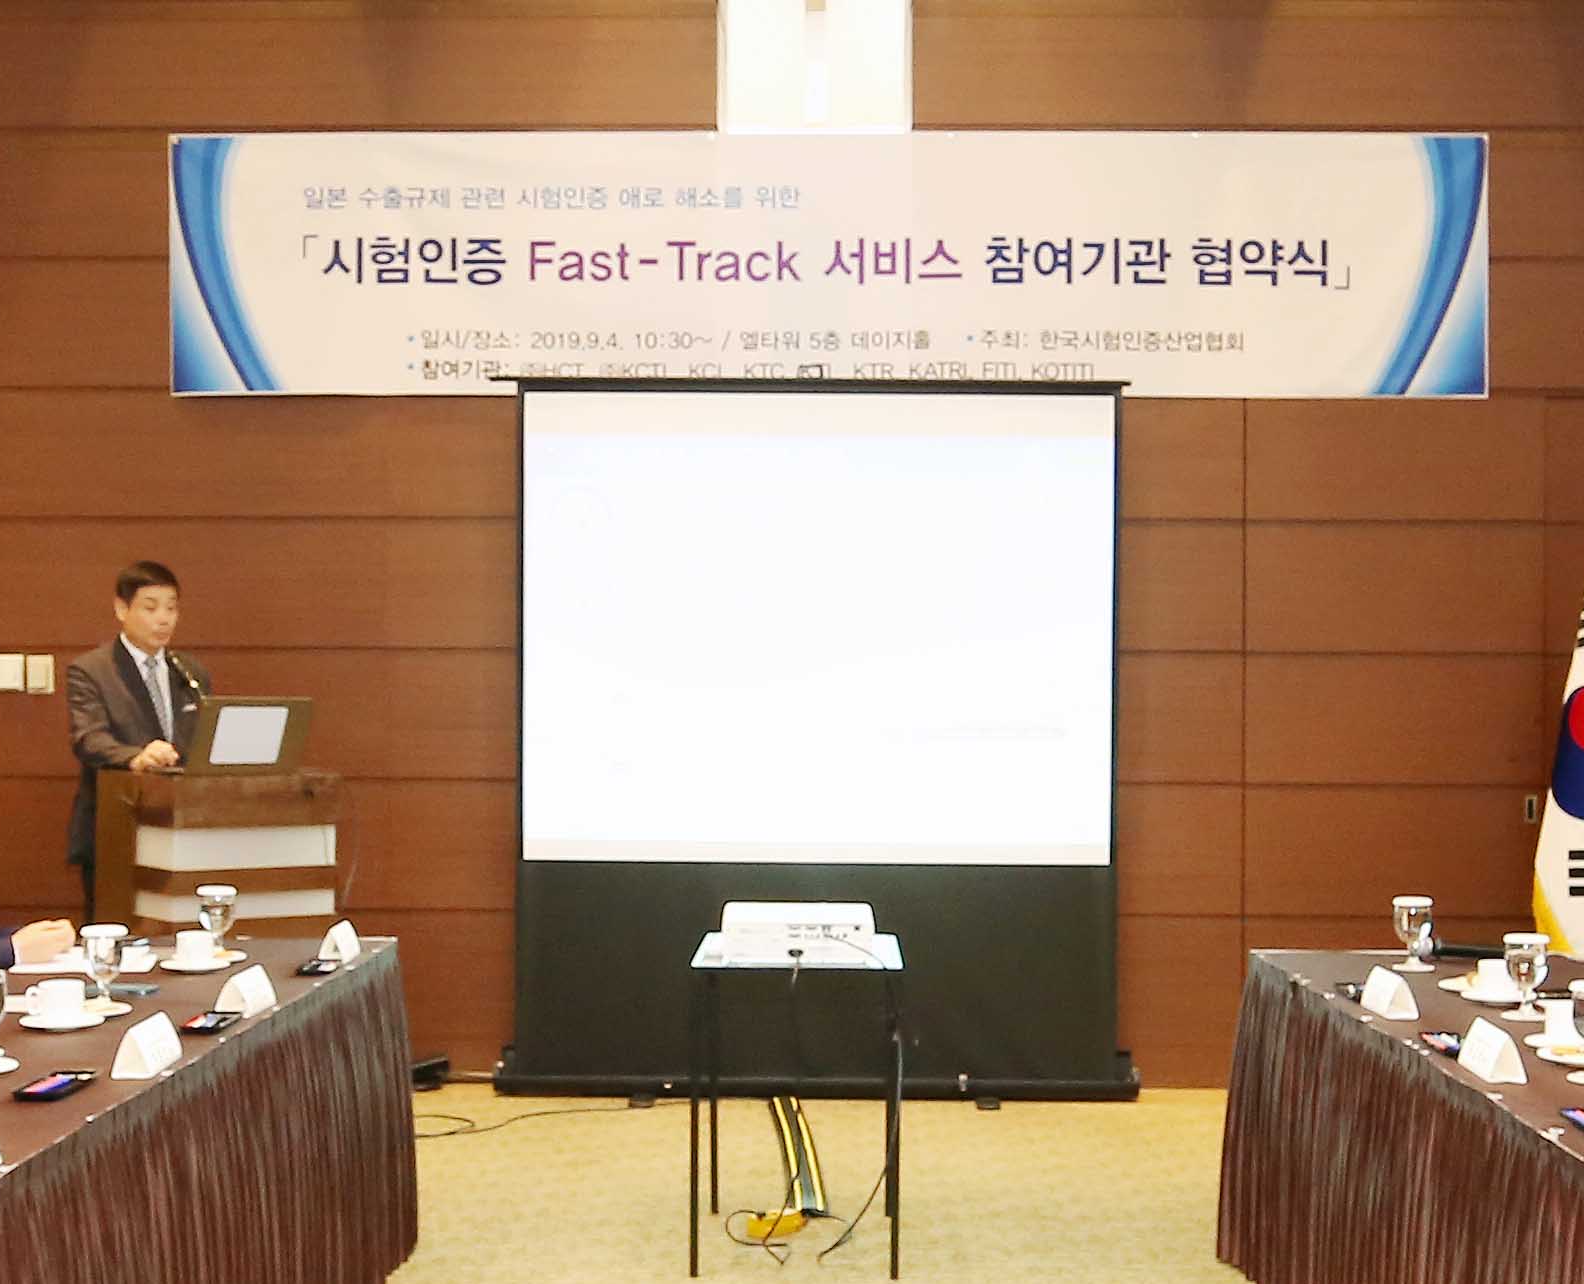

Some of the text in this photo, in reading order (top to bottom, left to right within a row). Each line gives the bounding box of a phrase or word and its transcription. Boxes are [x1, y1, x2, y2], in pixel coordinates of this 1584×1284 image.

[303, 186, 347, 209] 일본
[359, 187, 450, 209] 수출규제
[462, 187, 505, 209] 관련
[518, 186, 609, 210] 시험인증
[619, 187, 665, 209] 애로
[756, 186, 801, 209] 위한
[529, 240, 801, 282] Fast-Track
[824, 237, 963, 285] 서비스
[985, 236, 1172, 285] 참여기관
[530, 331, 624, 351] 2019.9.4.
[739, 330, 801, 351] 엘타워
[809, 330, 841, 351] 5층
[851, 329, 931, 351] 데이지홀
[1039, 329, 1245, 352] 한국시험인증산업협회
